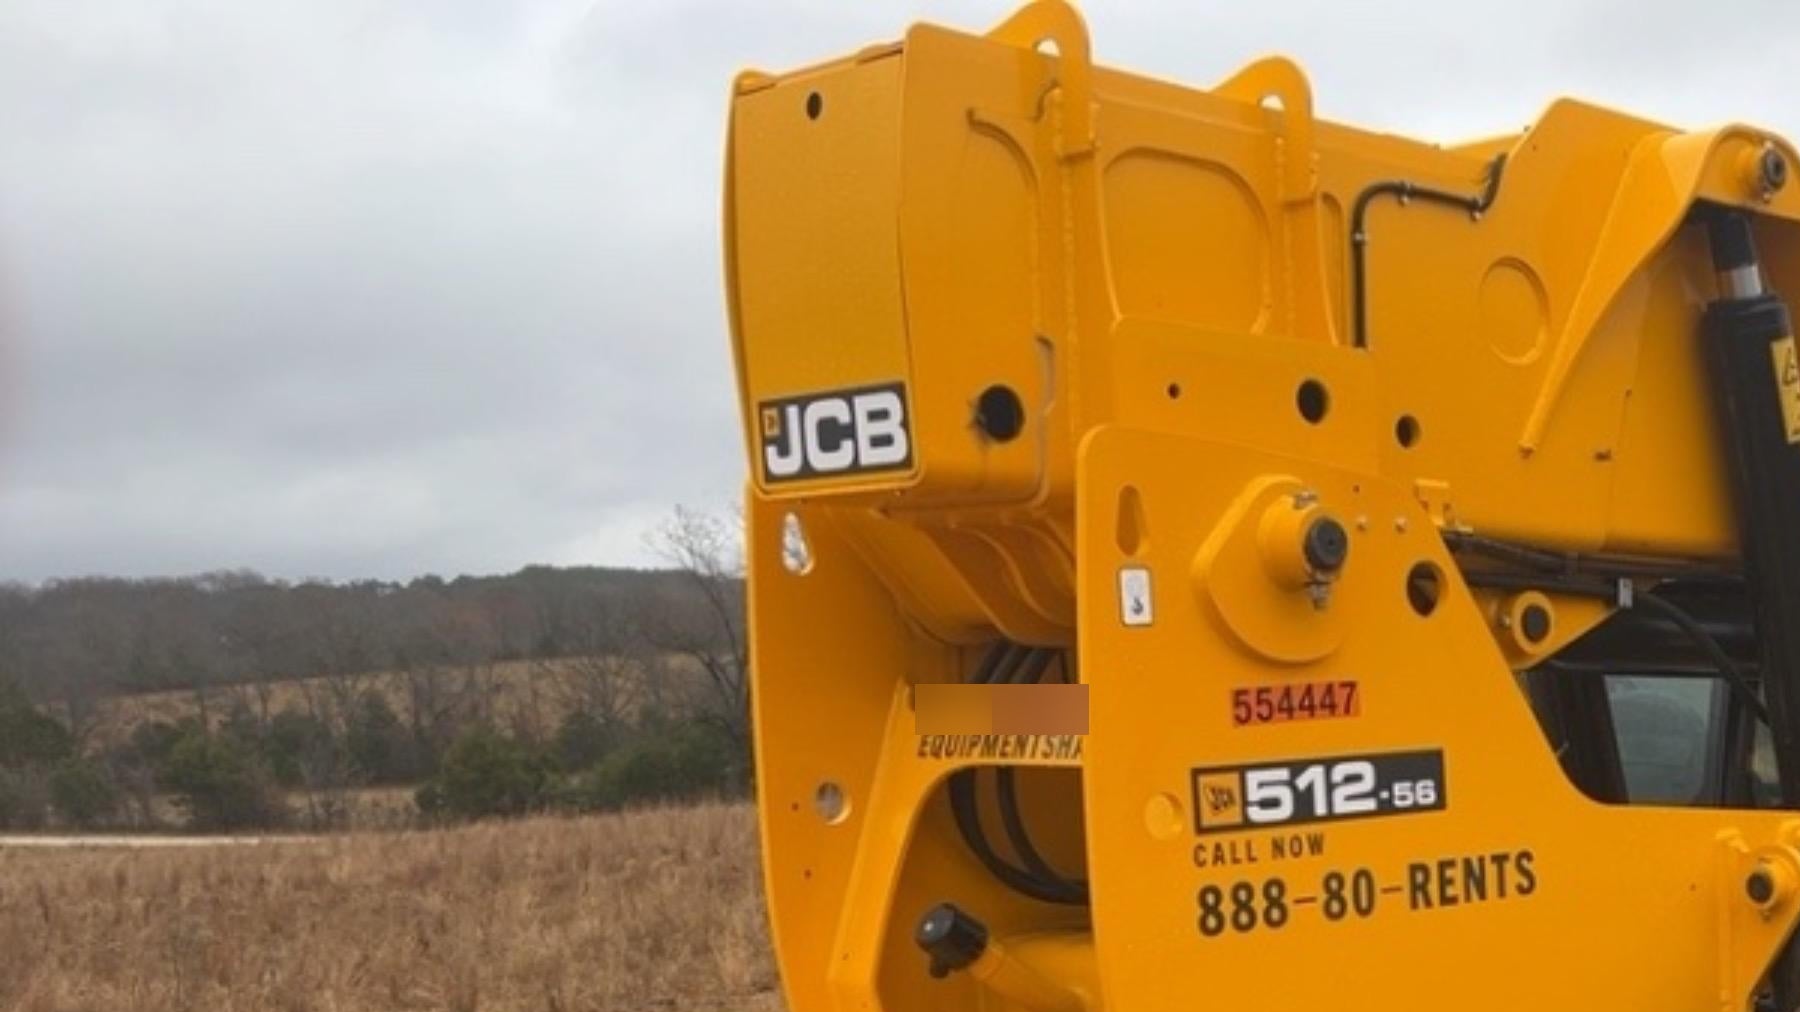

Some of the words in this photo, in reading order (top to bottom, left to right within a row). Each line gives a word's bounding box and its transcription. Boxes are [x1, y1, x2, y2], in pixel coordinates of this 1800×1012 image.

[765, 391, 908, 476] JCB
[1233, 682, 1358, 724] 554447
[1193, 841, 1258, 868] CALL
[1271, 833, 1325, 857] NOW
[1197, 851, 1537, 937] 888-80-RENTS
